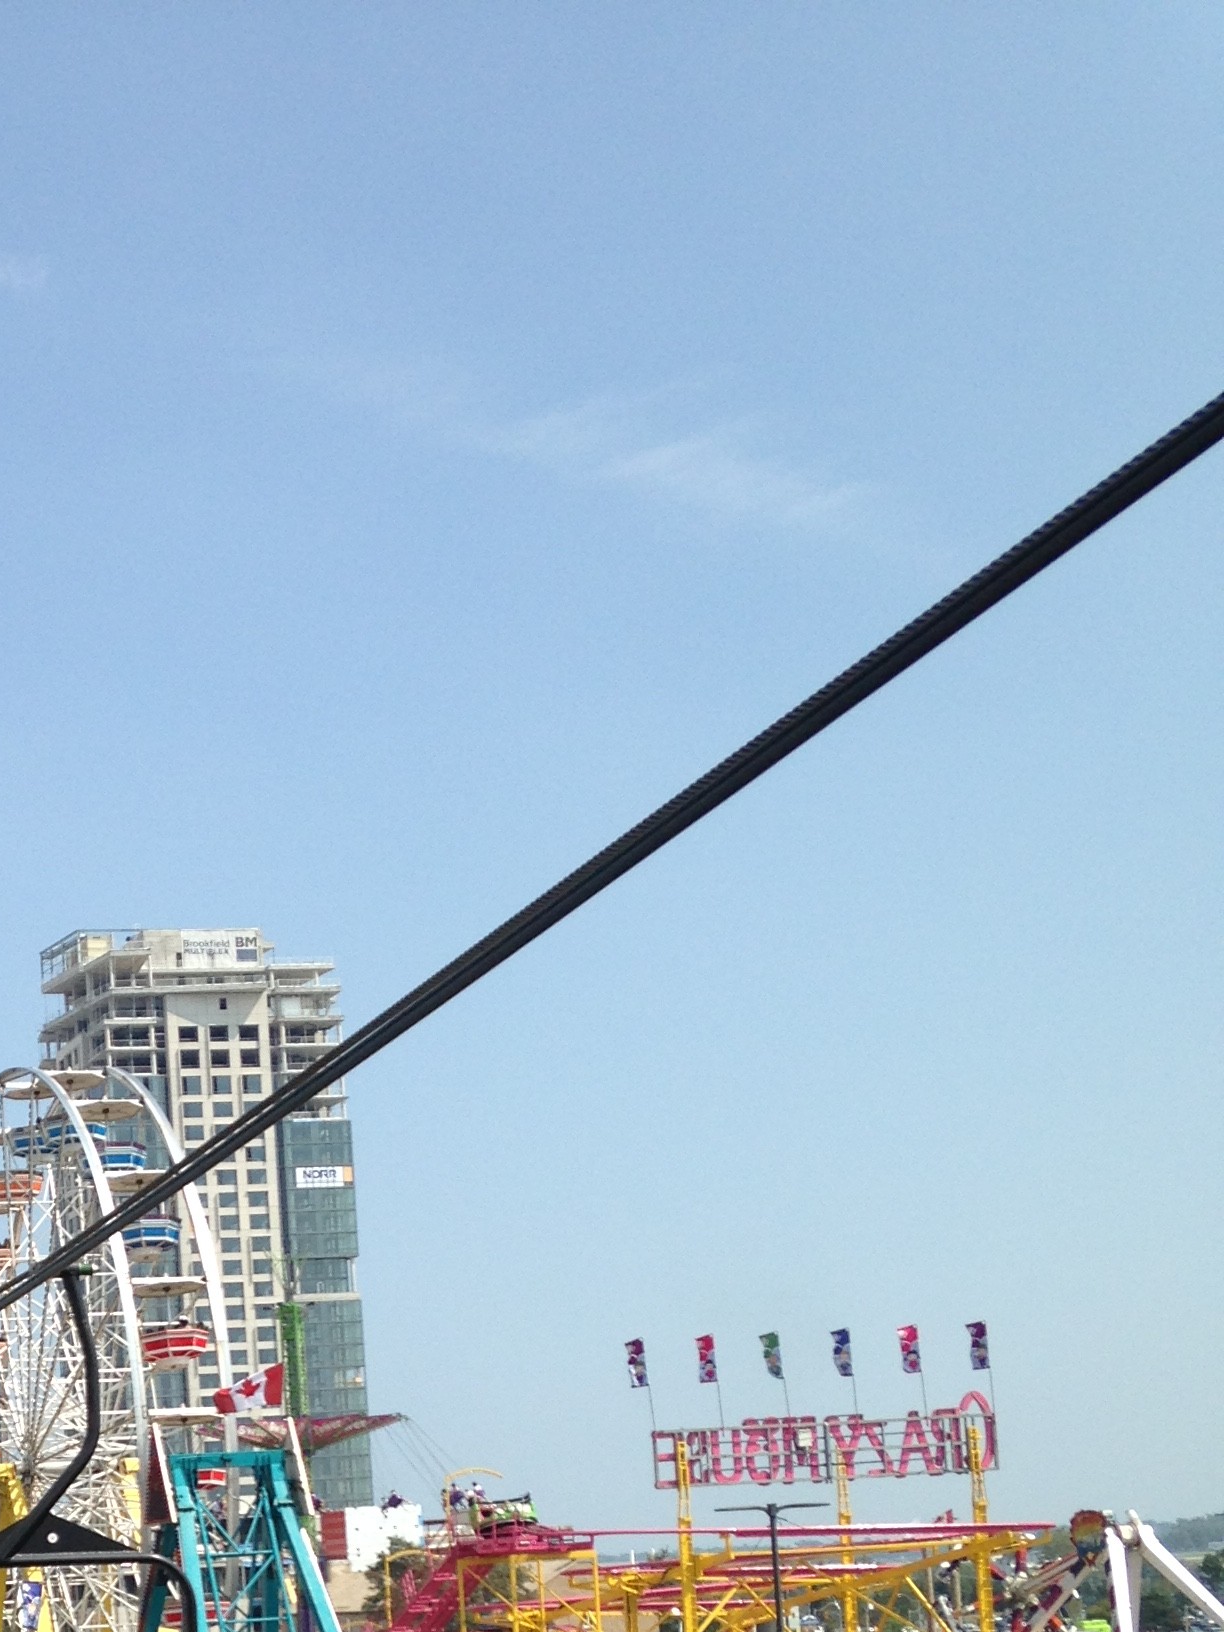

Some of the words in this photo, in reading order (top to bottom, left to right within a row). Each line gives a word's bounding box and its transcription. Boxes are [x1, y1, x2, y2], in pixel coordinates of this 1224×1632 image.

[183, 939, 230, 948] Brookfield
[235, 936, 258, 948] BM
[302, 1169, 337, 1179] NORR
